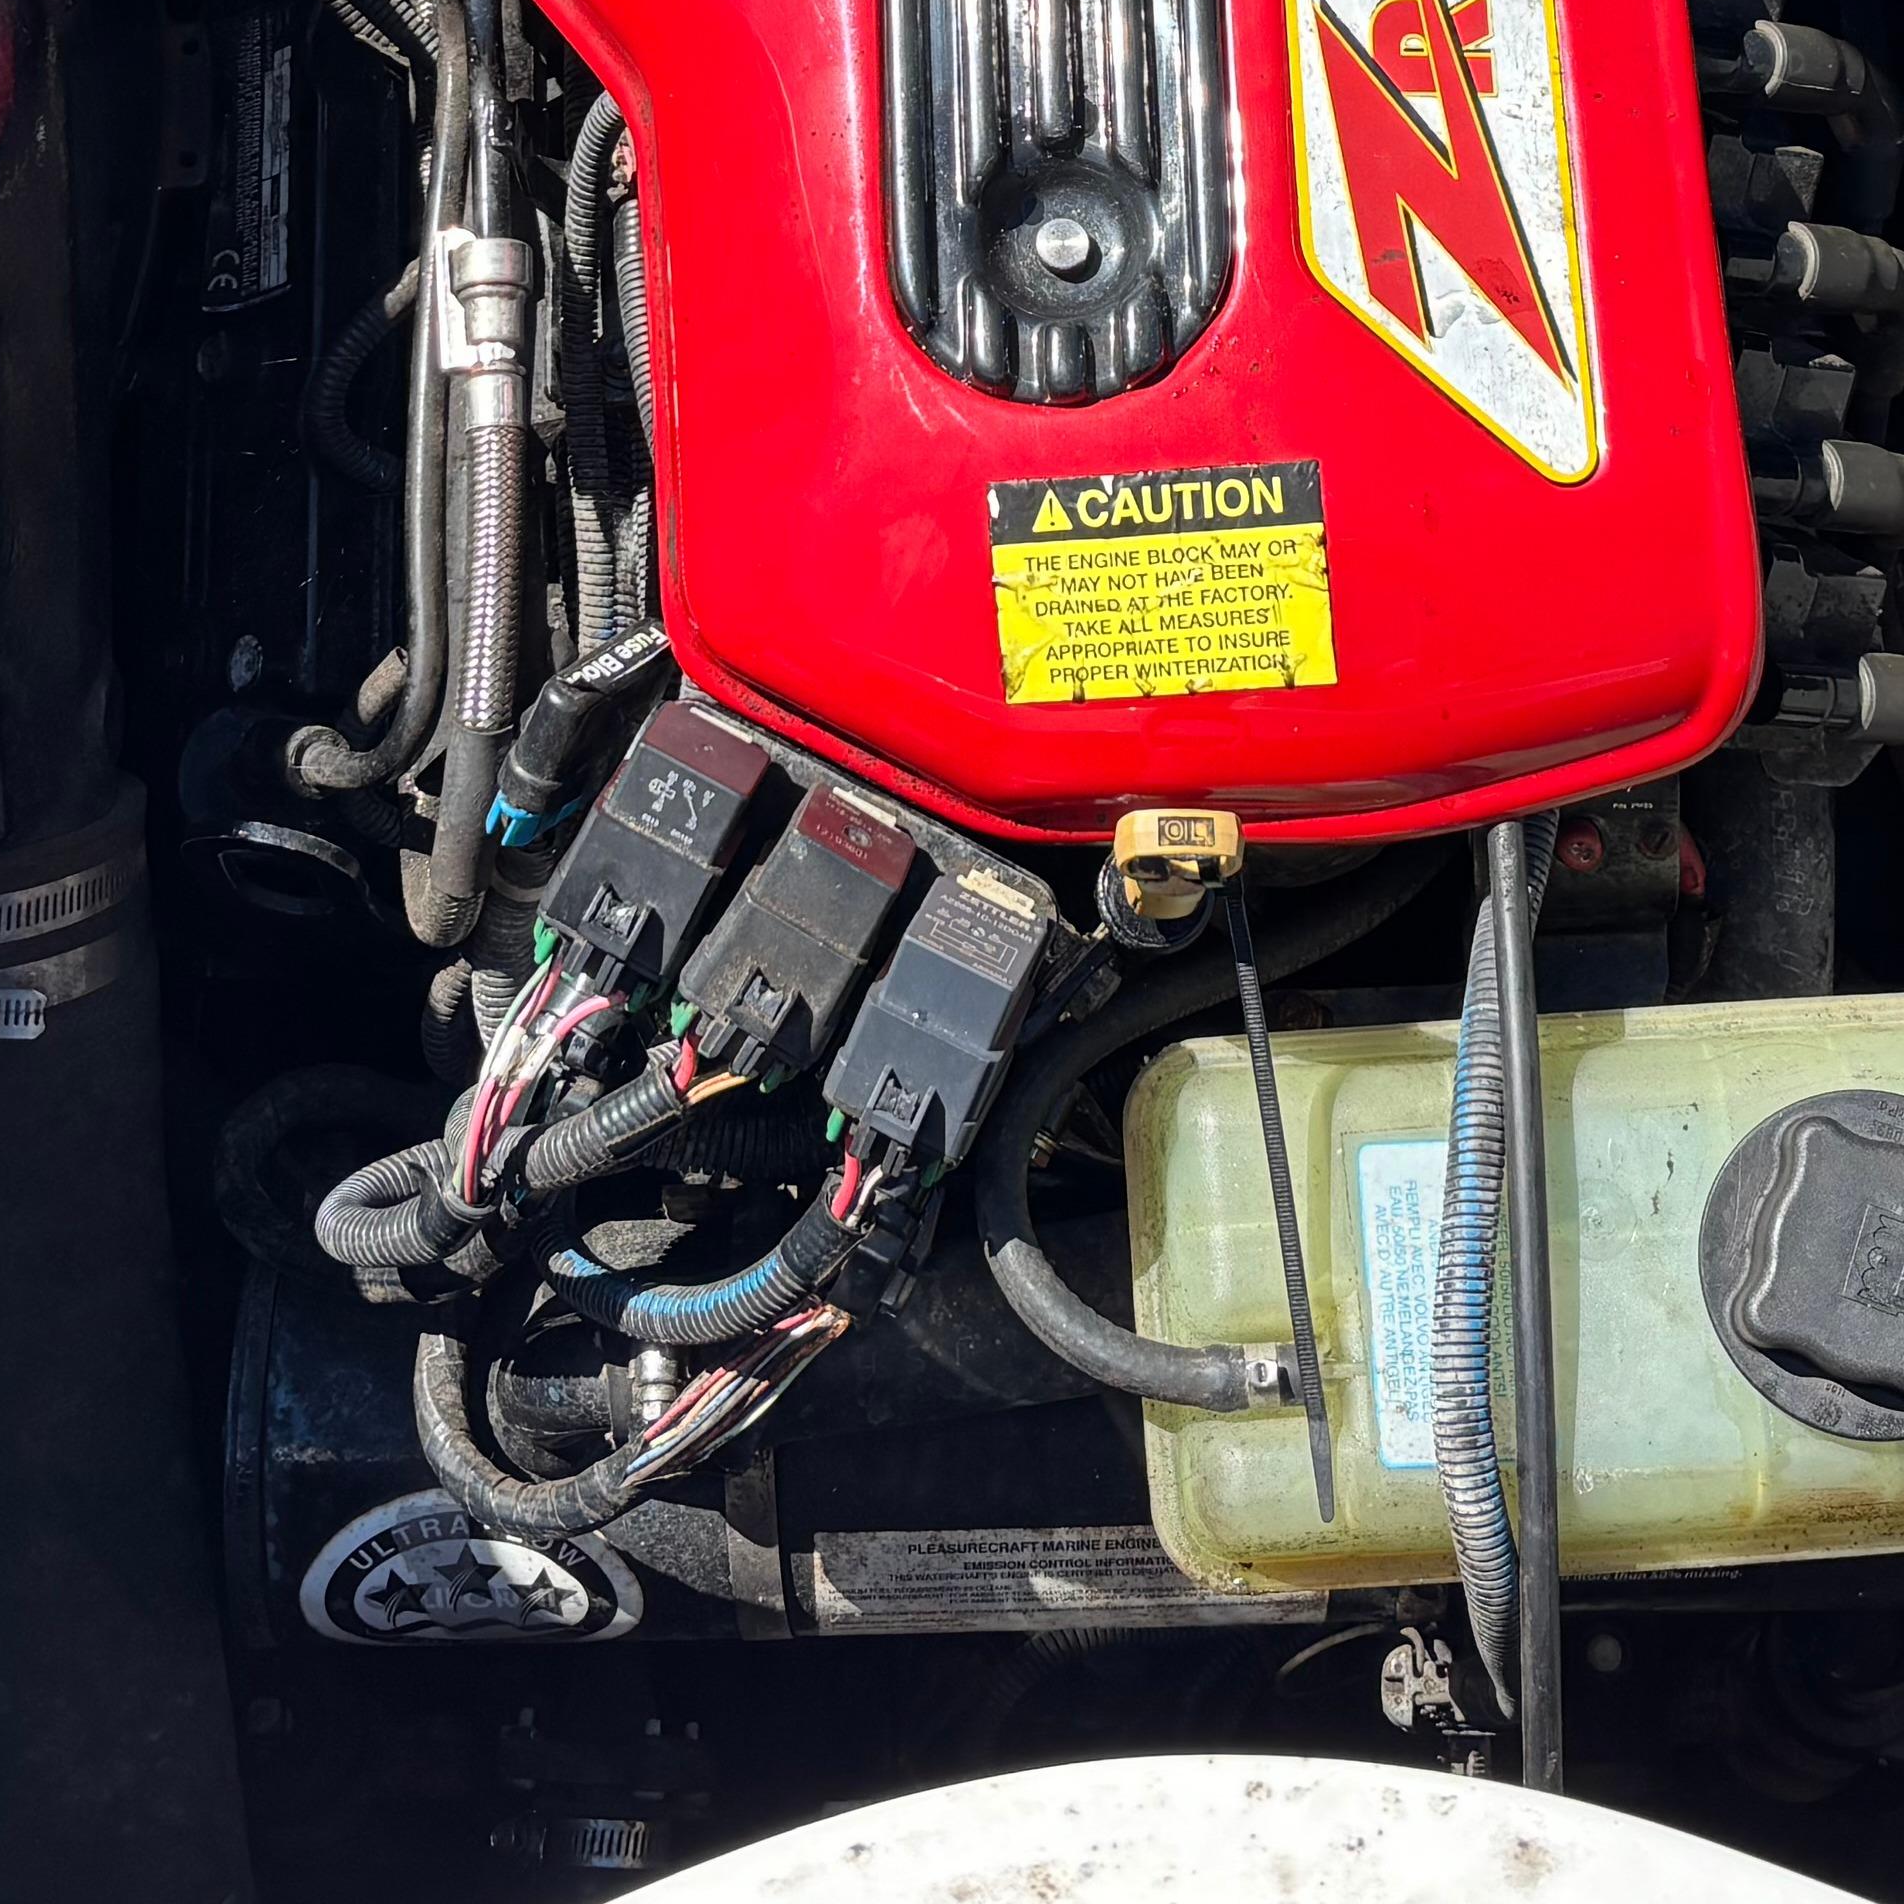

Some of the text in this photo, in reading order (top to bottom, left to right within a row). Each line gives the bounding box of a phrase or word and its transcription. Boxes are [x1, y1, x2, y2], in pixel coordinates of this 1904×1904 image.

[1076, 476, 1284, 528] CAUTION
[1024, 539, 1297, 572] THE ENGINE BLOCK MAY OR
[1060, 564, 1264, 594] MAY NOT HAVE BEEN
[1035, 598, 1121, 617] DRAINED
[1126, 595, 1148, 613] AT
[1200, 583, 1294, 605] FACTORY.
[1063, 608, 1269, 638] TAKE ALL MEASURES
[565, 626, 671, 684] Fuse Bloc
[1046, 630, 1291, 661] APPROPRIATE TO INSURE
[1049, 664, 1129, 683] PROPER
[1164, 819, 1204, 841] OIL
[1374, 1205, 1391, 1246] AVEC
[1396, 1269, 1410, 1292] NE
[1409, 1246, 1426, 1285] AVEC
[1379, 1270, 1397, 1324] AUTRE
[1413, 1292, 1431, 1346] VOLVO
[1398, 1295, 1415, 1389] MELANGEZ
[1404, 1391, 1420, 1422] PAS
[908, 1541, 1040, 1555] PLEASURECRAFT
[1043, 1540, 1101, 1552] MARINE
[889, 1574, 913, 1582] THIS
[963, 1560, 1026, 1571] EMISSION
[1029, 1559, 1091, 1569] CONTROL
